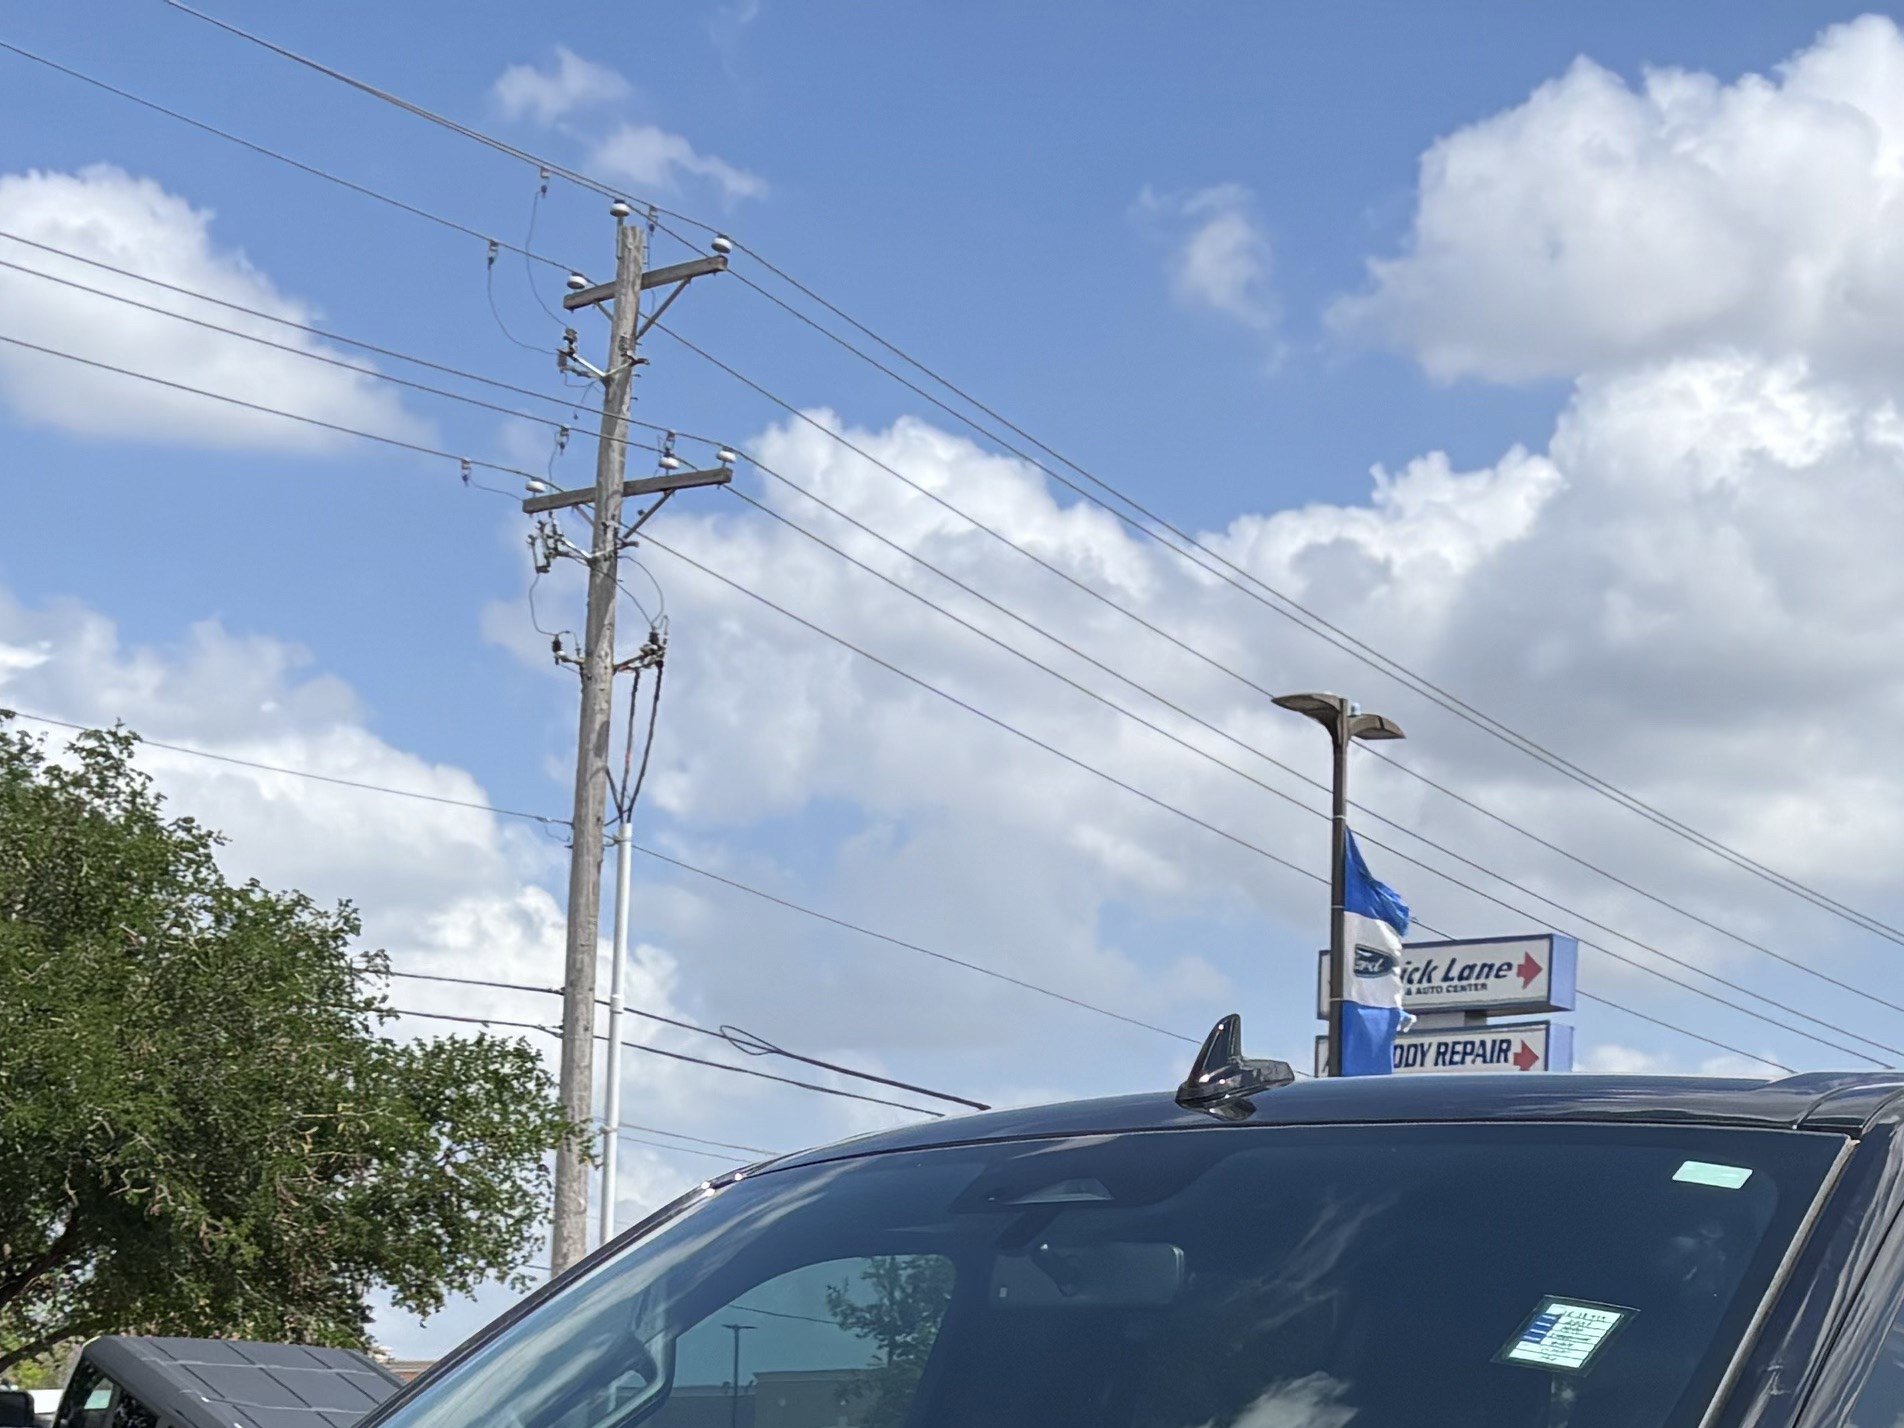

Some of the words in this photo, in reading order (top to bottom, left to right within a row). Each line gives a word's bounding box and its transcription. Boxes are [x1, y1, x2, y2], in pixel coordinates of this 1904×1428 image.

[1400, 959, 1438, 985] ick
[1441, 957, 1513, 982] Lane
[1393, 1042, 1432, 1068] ODY
[1434, 1039, 1511, 1067] REPAIR
